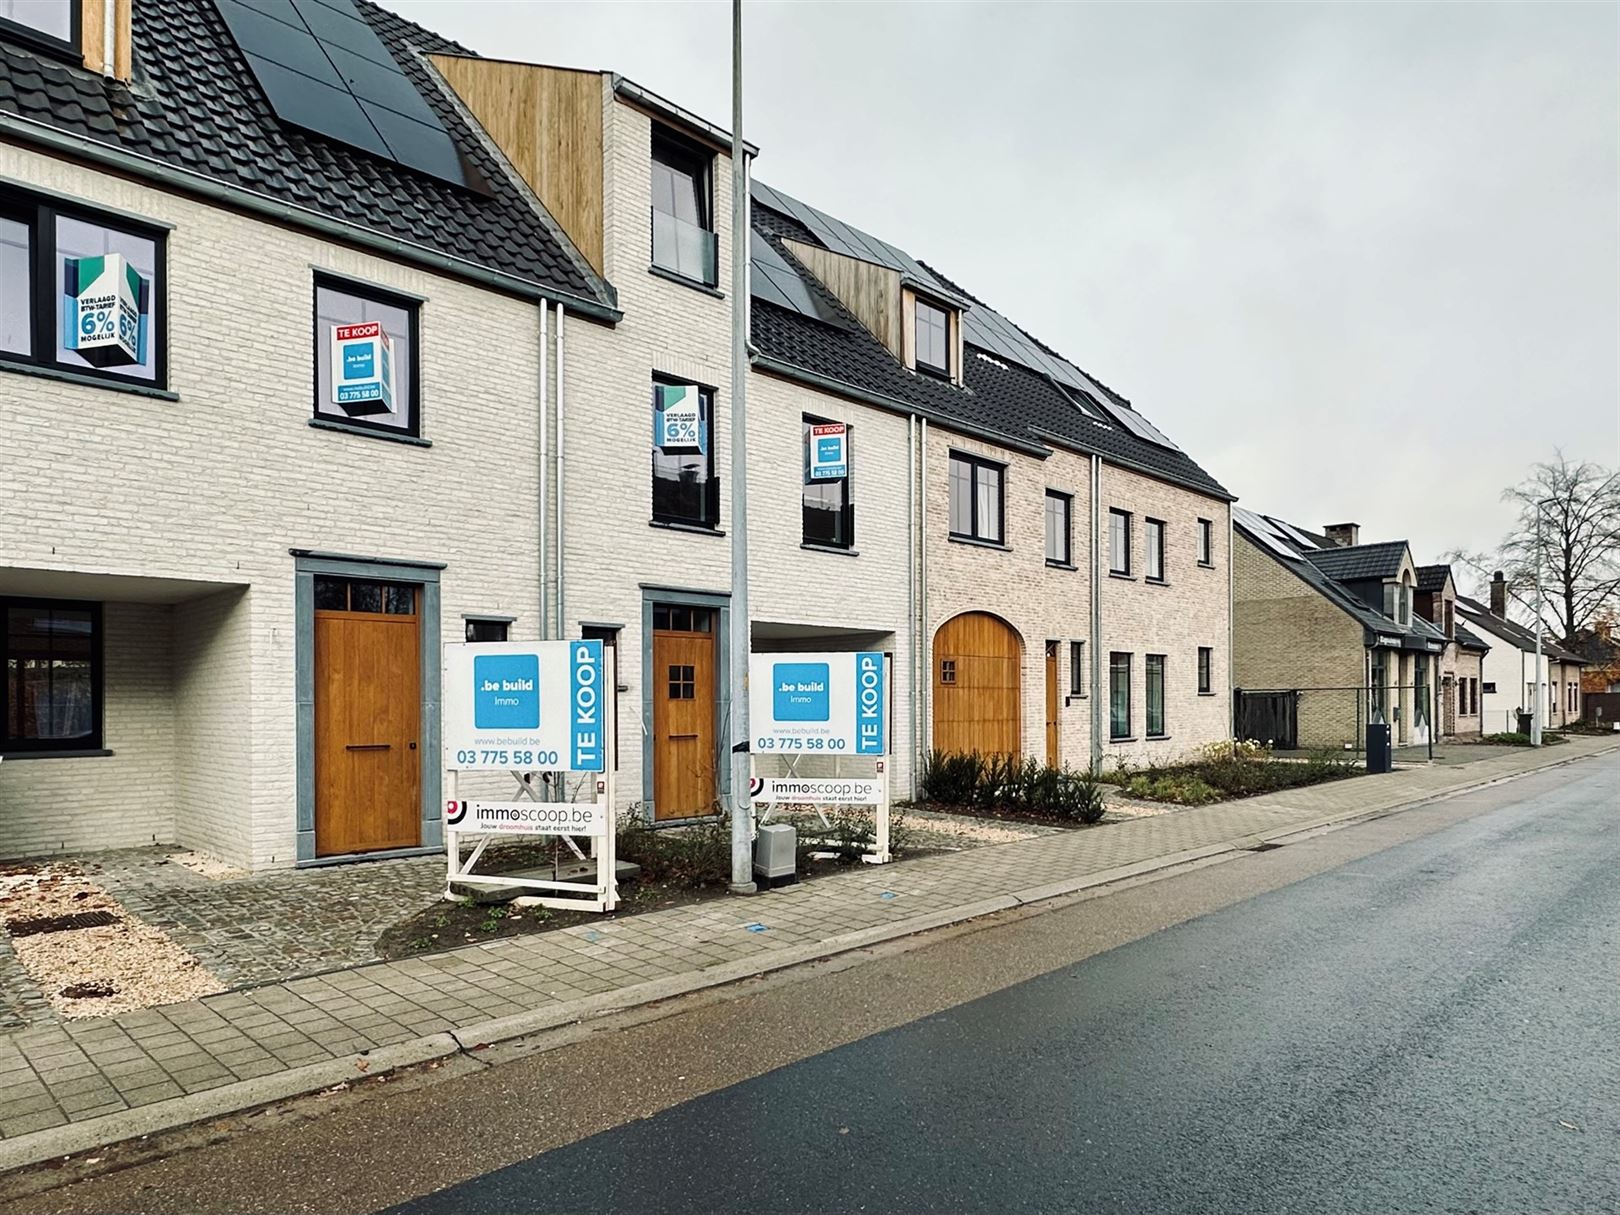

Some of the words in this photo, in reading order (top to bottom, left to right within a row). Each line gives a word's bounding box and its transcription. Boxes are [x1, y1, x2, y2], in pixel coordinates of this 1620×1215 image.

[80, 295, 116, 305] VERLAAGD
[80, 302, 116, 312] BTW-TARIEF
[81, 310, 115, 335] 6%
[120, 313, 136, 346] 6%
[338, 329, 350, 338] TE
[352, 326, 378, 336] KOOP
[80, 332, 115, 342] MOGELIJK
[349, 391, 361, 399] 775
[361, 390, 369, 398] 58
[370, 389, 379, 397] 00
[667, 423, 696, 437] 6%
[480, 680, 500, 691] .be
[502, 678, 533, 691] build
[576, 646, 596, 724] KOOP
[797, 681, 824, 691] build
[861, 657, 878, 718] KOOP
[494, 696, 520, 706] Immo
[790, 695, 812, 704] Immo
[773, 727, 831, 735] www.bebuild.be
[861, 724, 878, 750] TE
[474, 737, 541, 746] www.bebuild.be
[757, 737, 775, 749] 03
[778, 738, 803, 749] 775
[806, 738, 824, 749] 58
[827, 738, 846, 749] 00
[577, 732, 596, 765] TE
[457, 750, 476, 764] 03
[480, 750, 509, 764] 775
[513, 751, 533, 764] 58
[537, 751, 558, 765] 00
[771, 780, 872, 795] immoscoop.be
[476, 804, 593, 825] immoscoop.be
[498, 823, 534, 831] droomhuis
